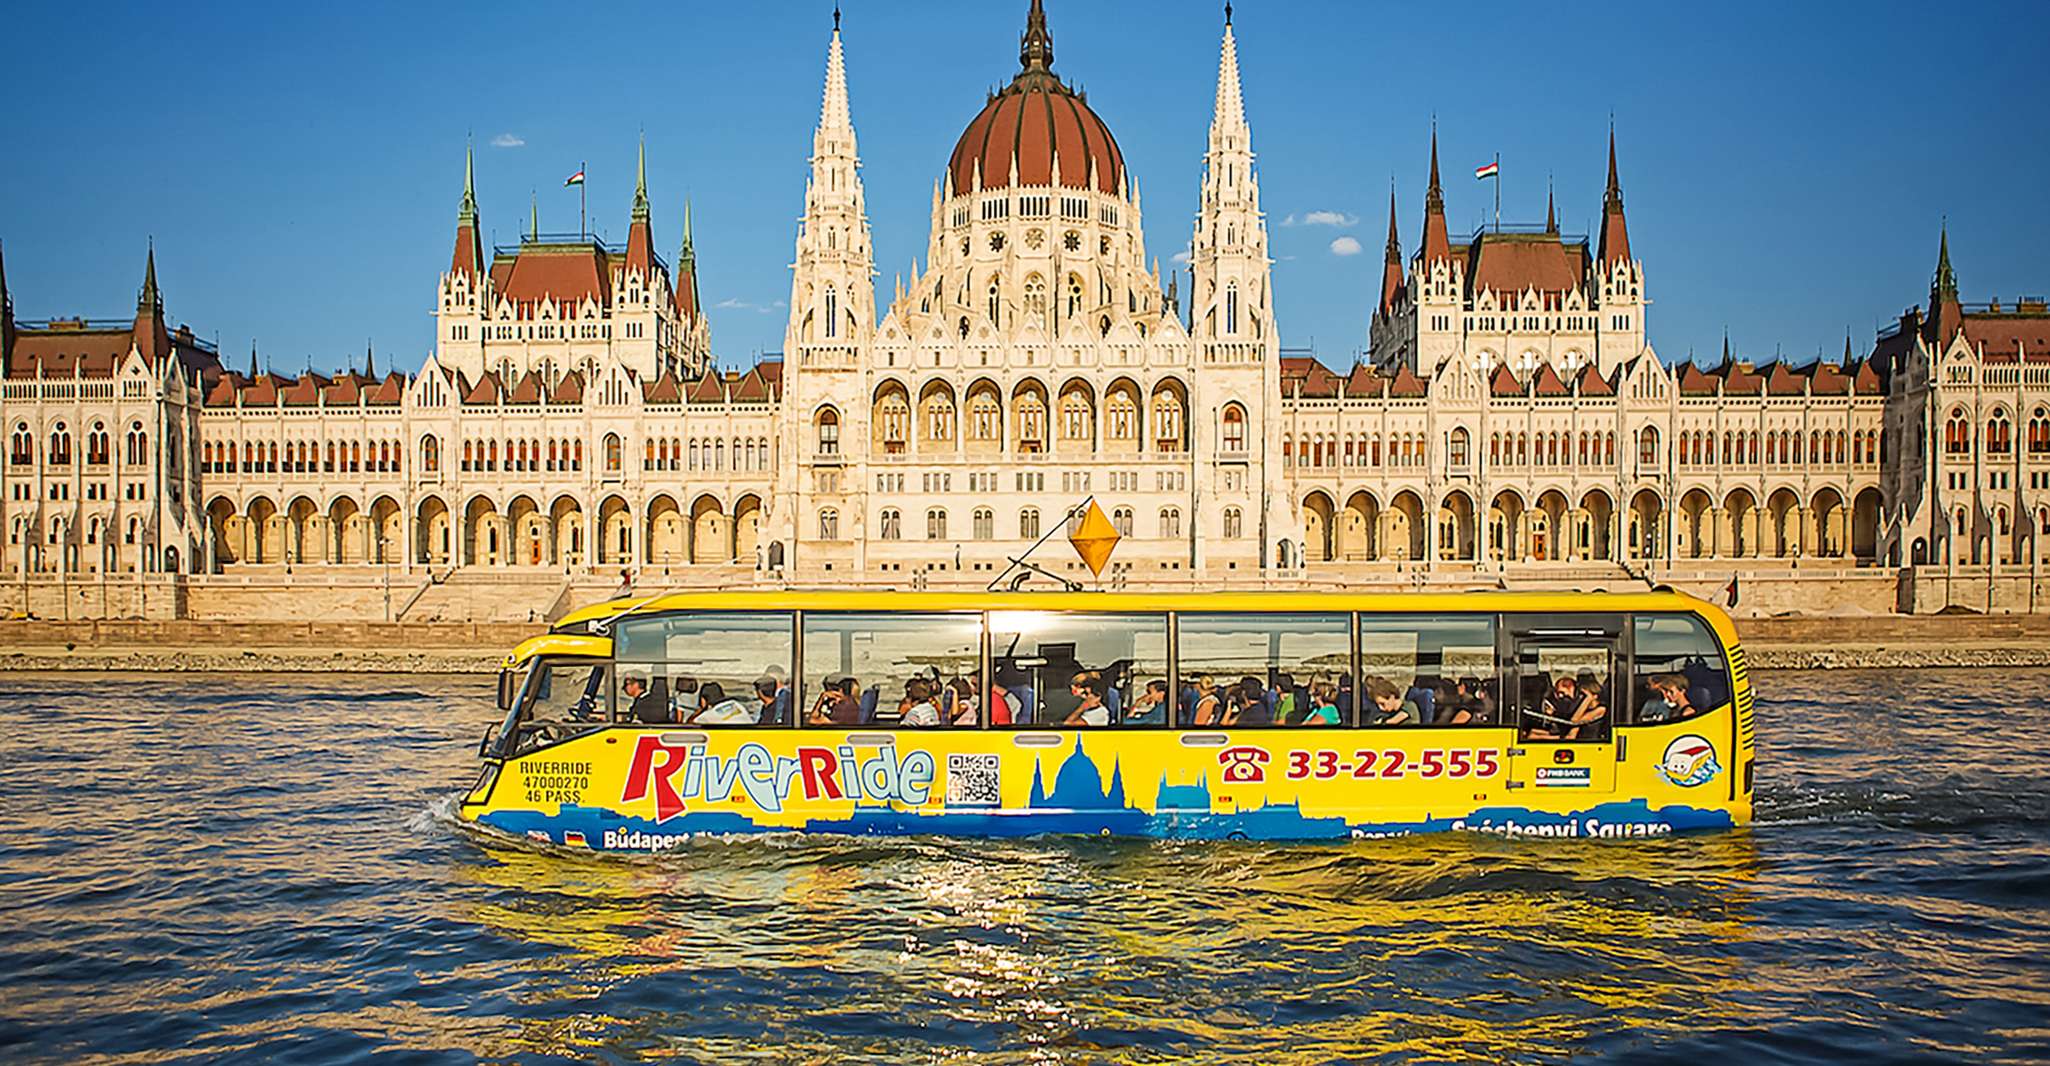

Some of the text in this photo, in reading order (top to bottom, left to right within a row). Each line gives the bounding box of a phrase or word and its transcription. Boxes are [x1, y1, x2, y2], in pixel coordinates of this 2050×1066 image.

[520, 761, 593, 775] RIVERRIDE
[1287, 750, 1499, 779] 33-22-555
[523, 776, 588, 789] 47000270
[622, 736, 935, 824] RiverRide
[525, 790, 586, 803] 46 PASS.
